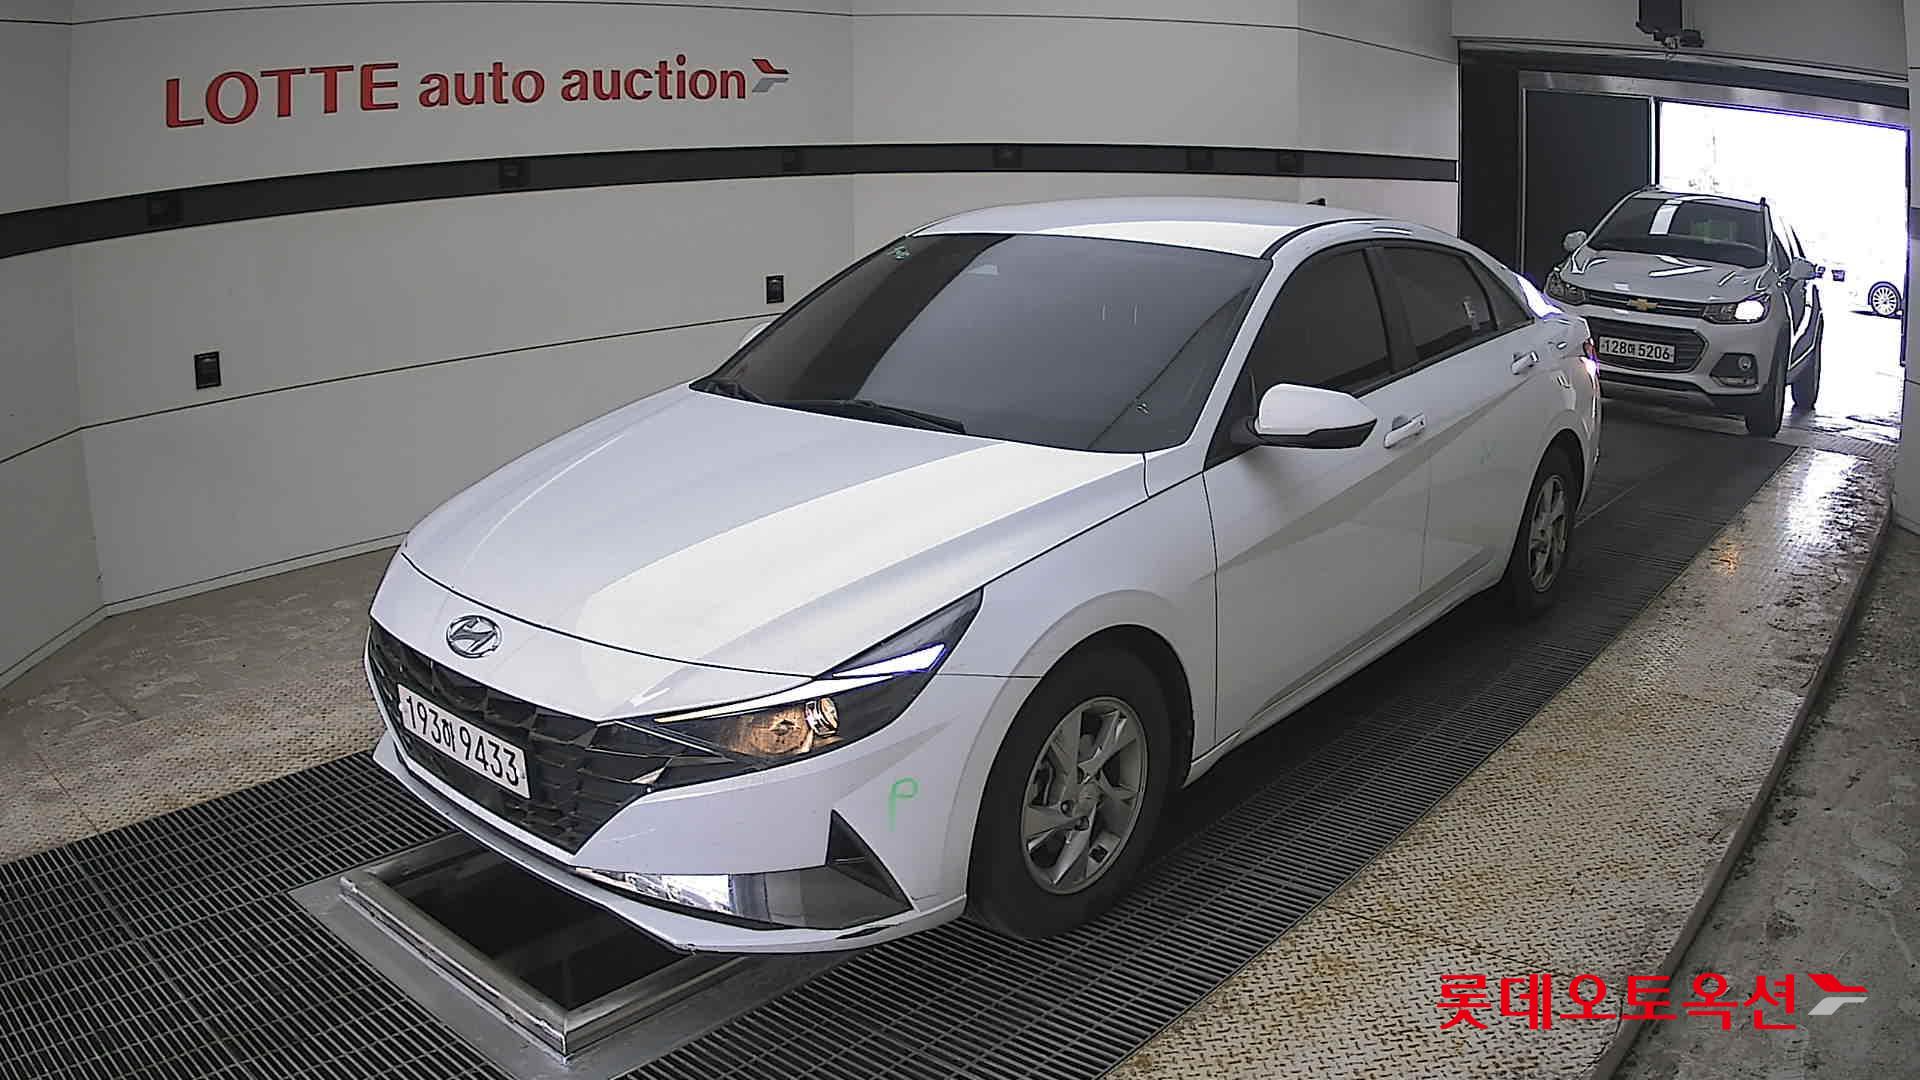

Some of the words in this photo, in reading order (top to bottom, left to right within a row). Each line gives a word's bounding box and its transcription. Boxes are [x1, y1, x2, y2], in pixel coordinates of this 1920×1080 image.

[166, 62, 399, 128] LOTTE
[418, 61, 545, 107] auto
[560, 54, 746, 101] auction
[1638, 344, 1670, 360] 5206
[460, 726, 519, 786] 9433
